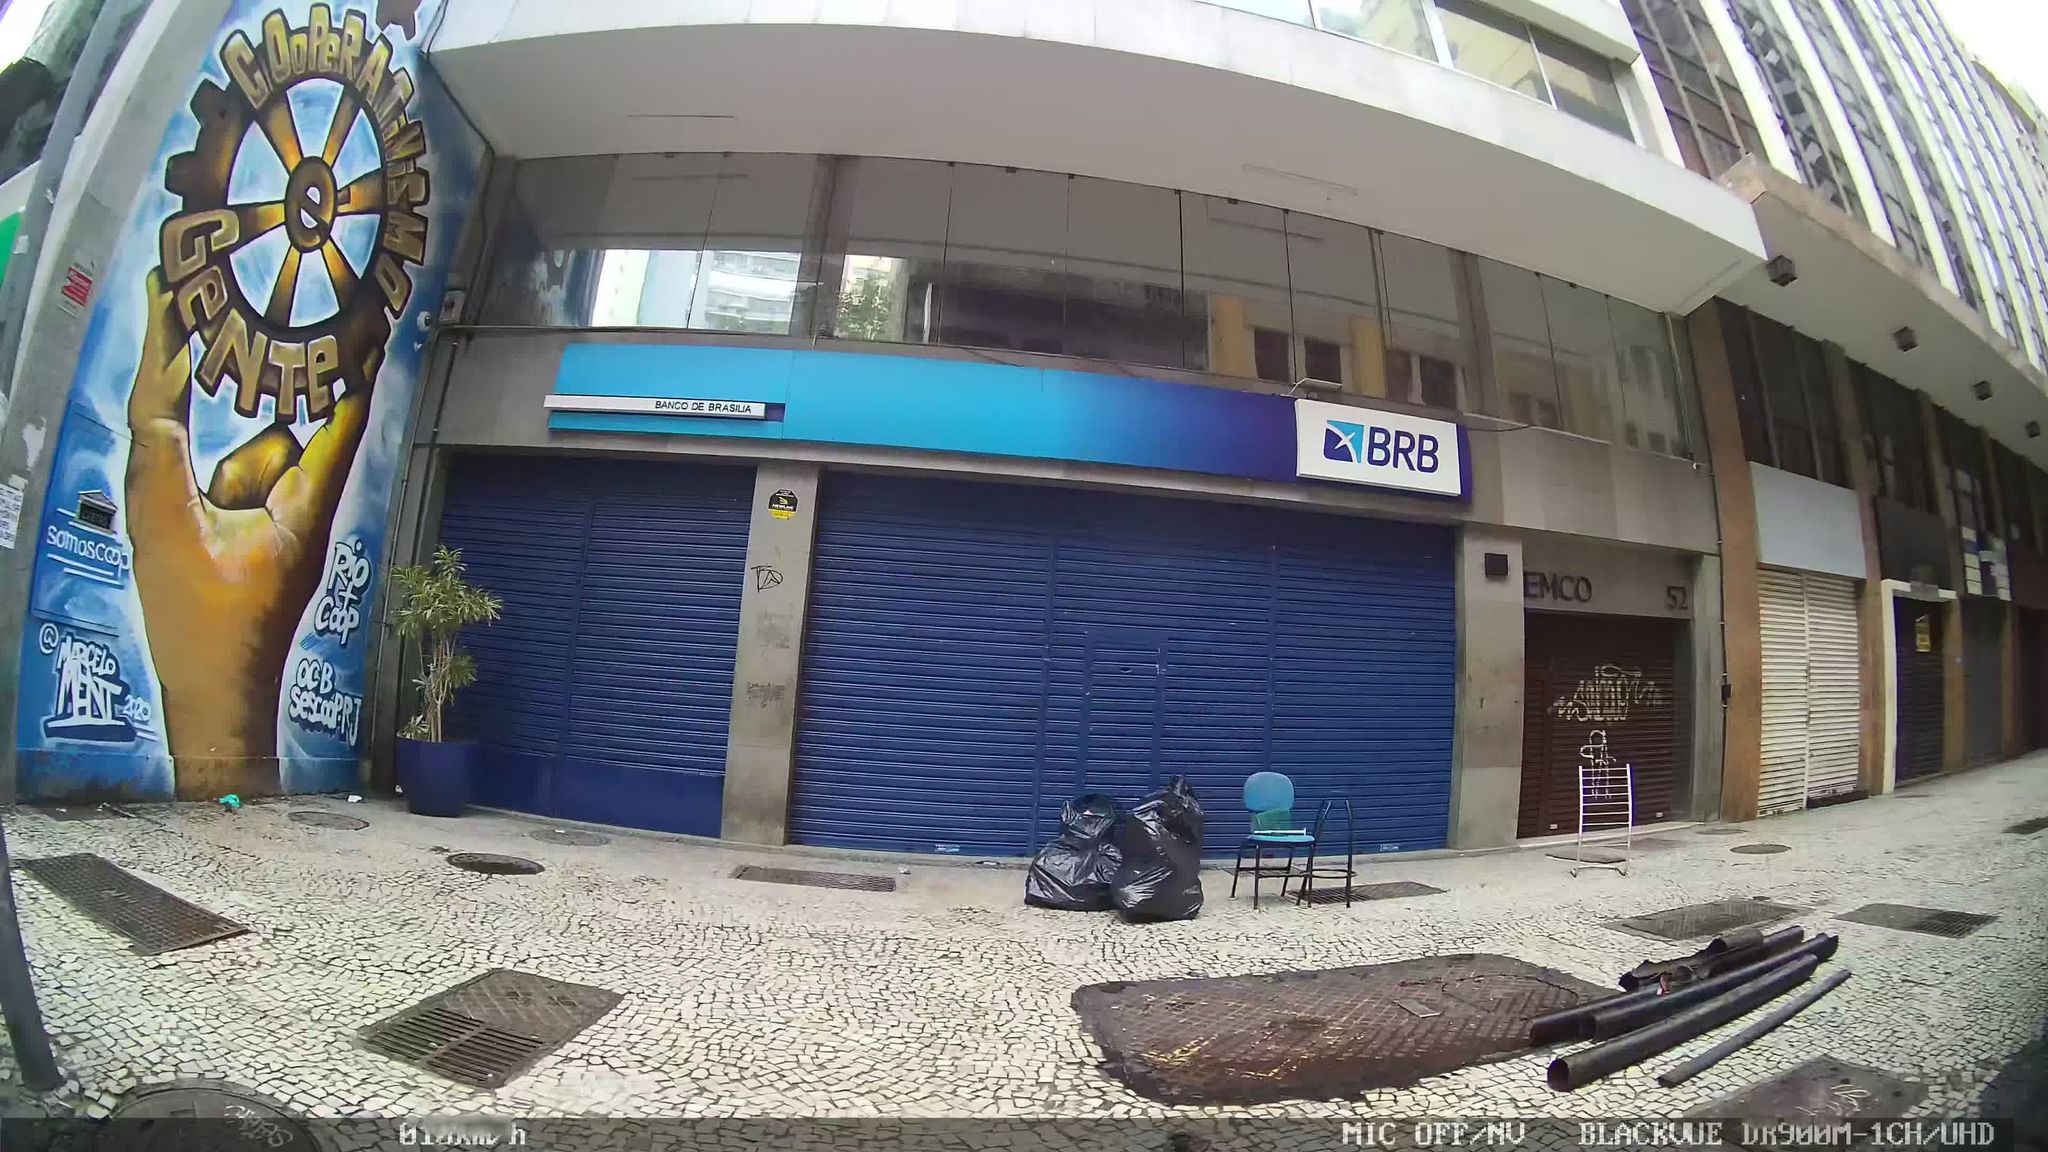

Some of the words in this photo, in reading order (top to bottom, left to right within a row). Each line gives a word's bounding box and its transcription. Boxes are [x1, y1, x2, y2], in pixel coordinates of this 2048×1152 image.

[655, 400, 689, 411] BANCO
[691, 402, 704, 412] DE
[708, 403, 751, 413] BRASILIA
[1367, 426, 1439, 474] BRB
[328, 541, 370, 590] Rio
[1523, 571, 1592, 603] EMCO
[296, 660, 334, 694] OCB
